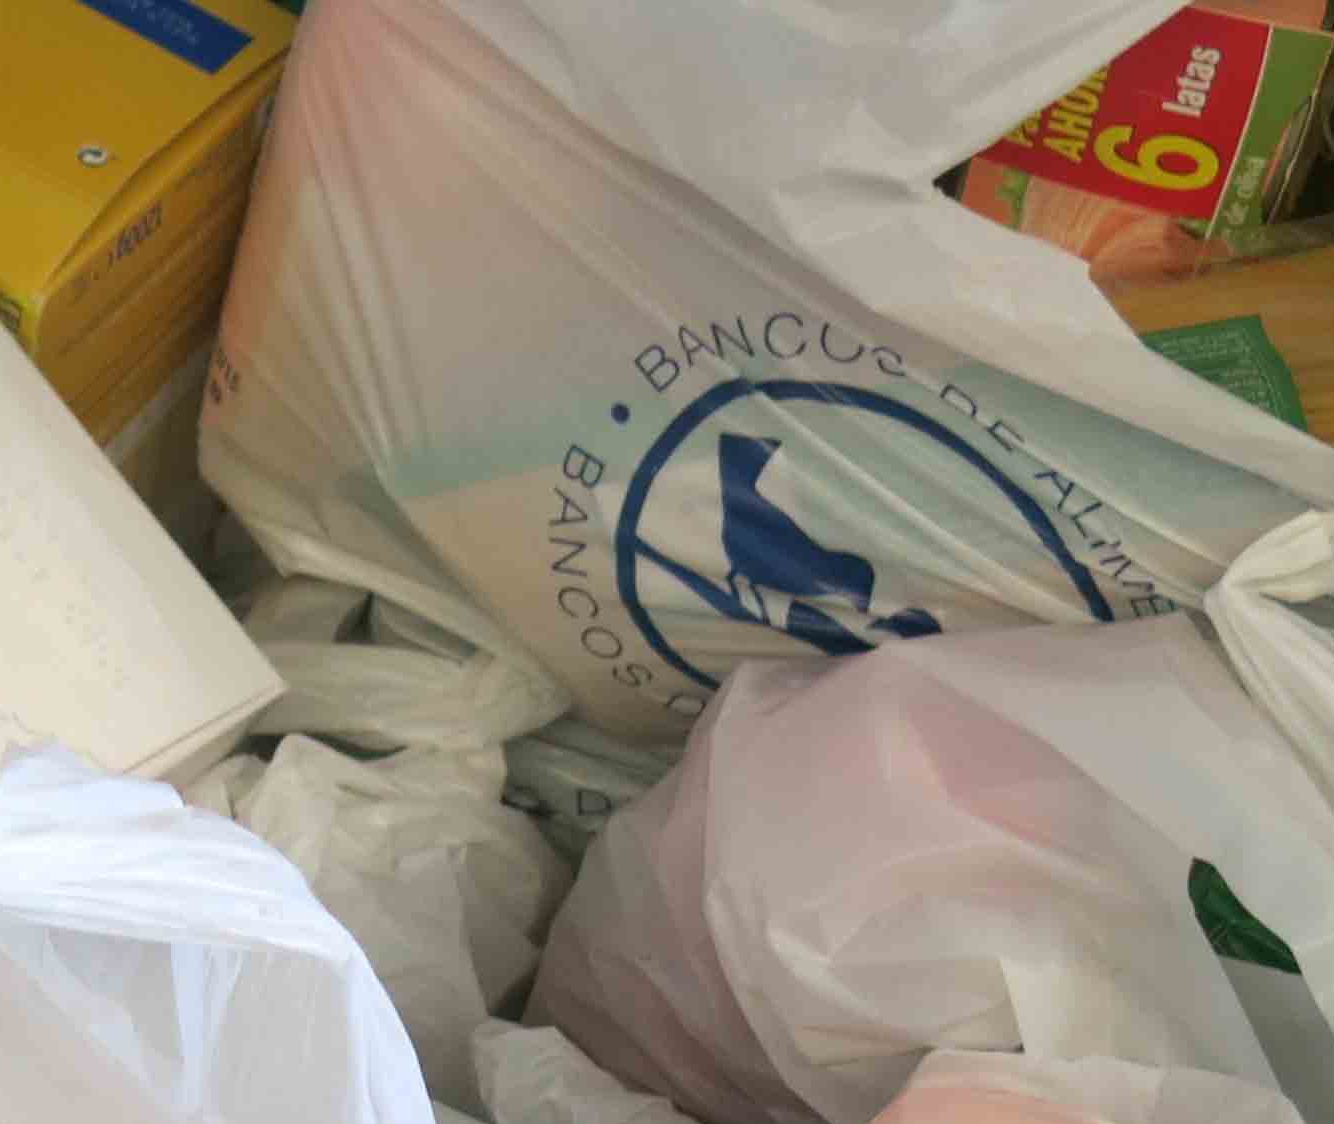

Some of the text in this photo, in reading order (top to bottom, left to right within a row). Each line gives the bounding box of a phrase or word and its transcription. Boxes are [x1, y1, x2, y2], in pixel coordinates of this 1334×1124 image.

[1163, 46, 1221, 119] latas
[1093, 124, 1220, 191] 6
[549, 444, 655, 690] BANCOS
